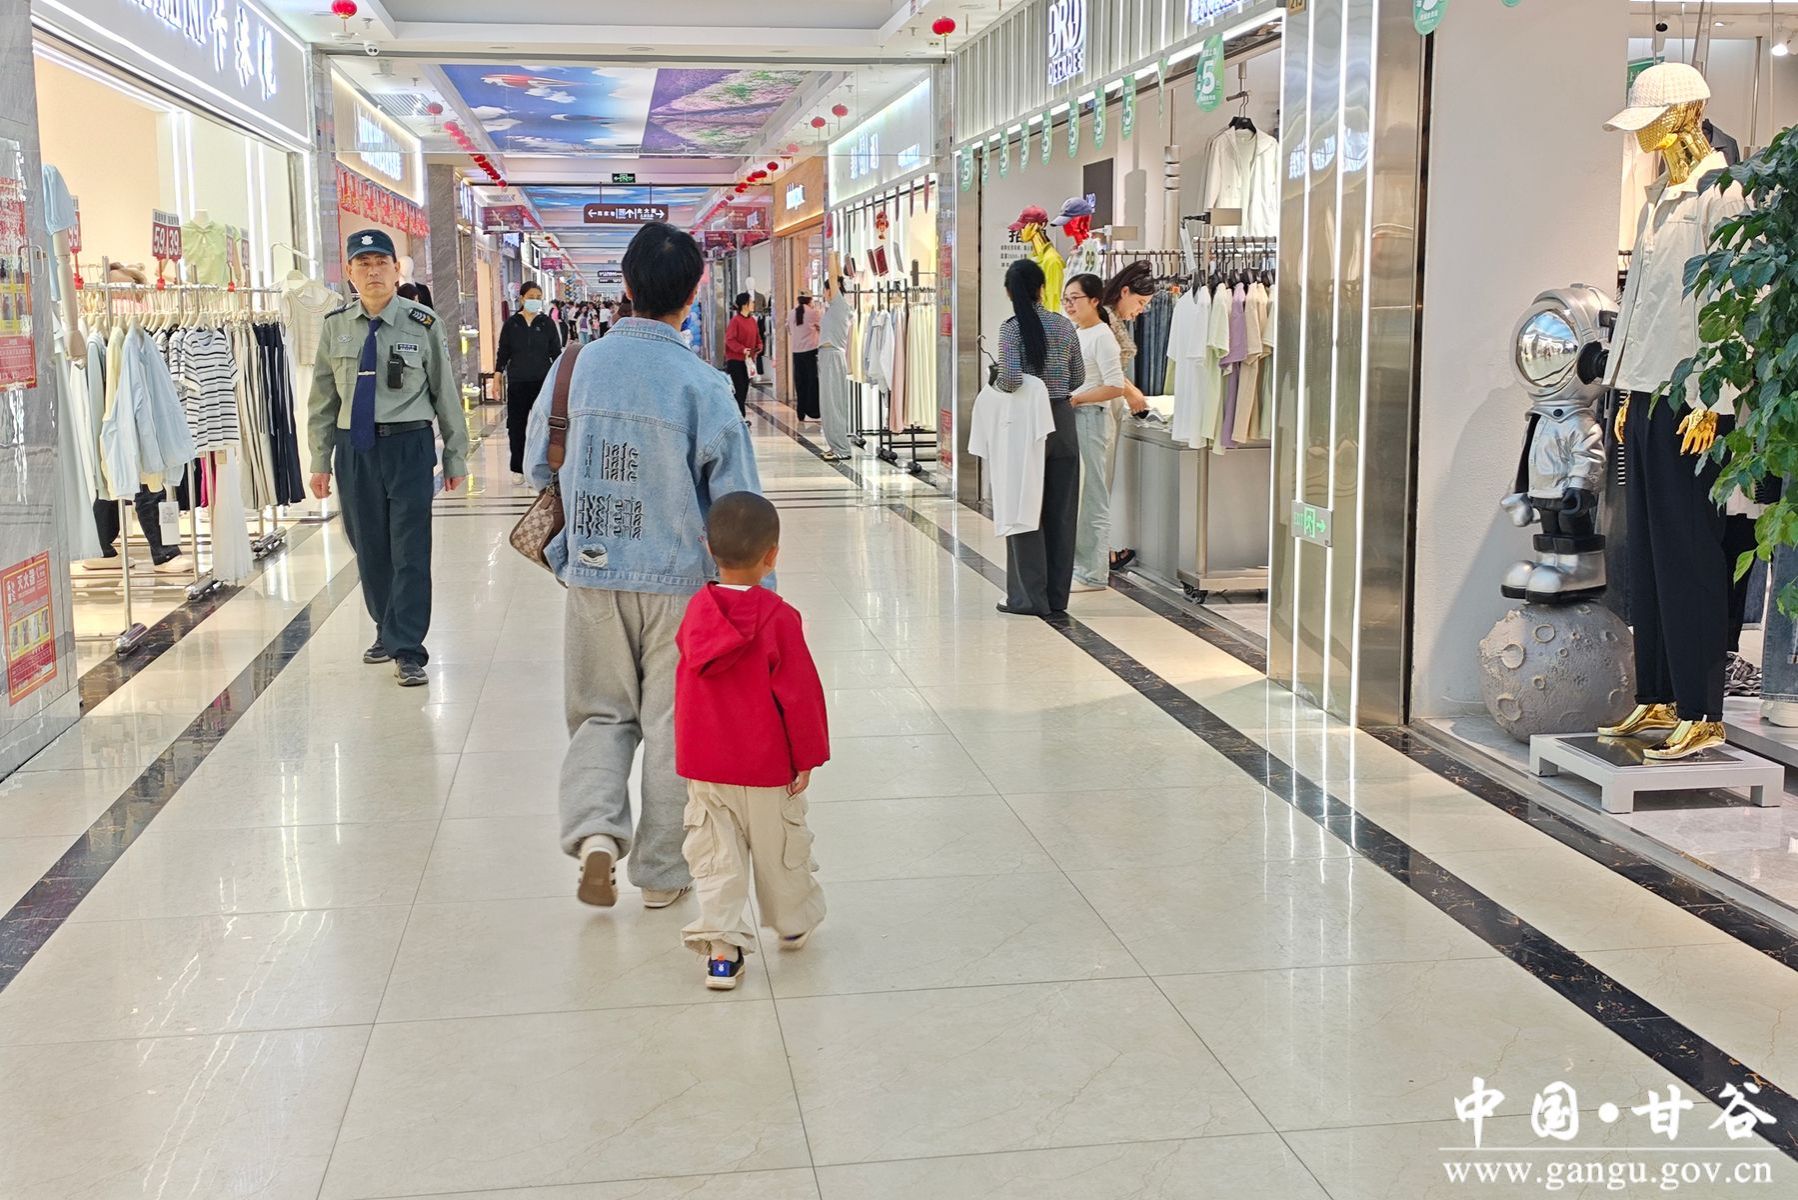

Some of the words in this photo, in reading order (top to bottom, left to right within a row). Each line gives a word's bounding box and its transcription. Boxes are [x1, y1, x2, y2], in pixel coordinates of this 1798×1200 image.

[1201, 60, 1215, 94] 5
[154, 226, 166, 254] 59
[168, 229, 180, 256] 39
